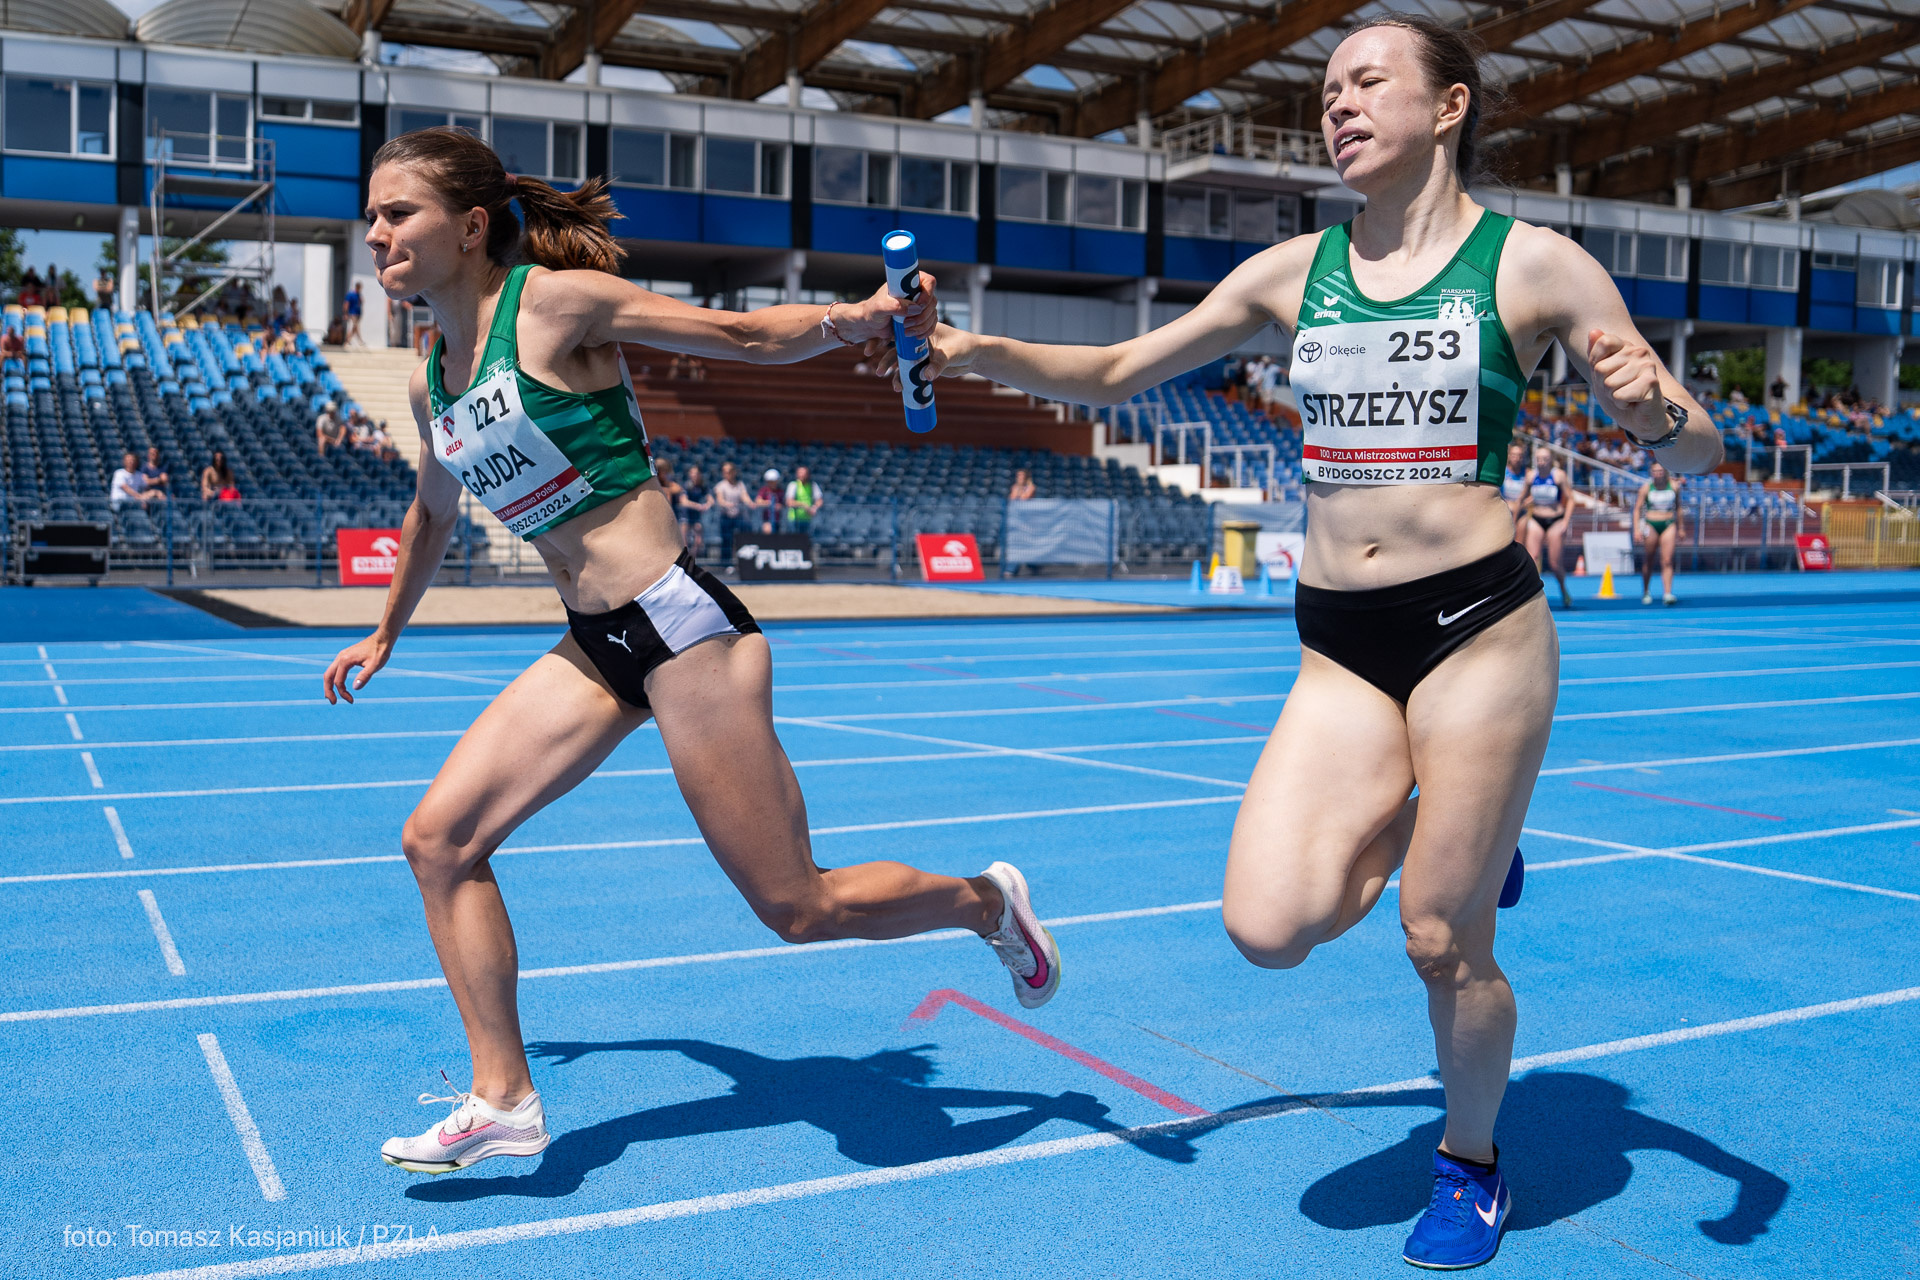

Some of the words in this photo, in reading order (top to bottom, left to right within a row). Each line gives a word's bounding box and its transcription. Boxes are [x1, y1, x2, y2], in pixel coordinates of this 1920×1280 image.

[1314, 308, 1342, 319] erima
[1329, 344, 1366, 356] Okęcie
[1388, 329, 1461, 362] 253
[468, 387, 511, 432] 221
[1303, 381, 1469, 427] STRZEŻYSZ
[445, 438, 464, 456] ORLEN
[1319, 448, 1332, 459] 100.
[1332, 451, 1353, 460] PZLA
[1354, 450, 1416, 460] Mistrzostwa
[1418, 448, 1450, 459] Polski
[461, 444, 537, 497] GAJDA
[1318, 466, 1405, 480] BYDGOSZCZ
[1409, 467, 1453, 480] 2024
[504, 496, 537, 517] Mistrzostwa
[535, 481, 560, 500] Polski
[540, 493, 572, 518] 2024
